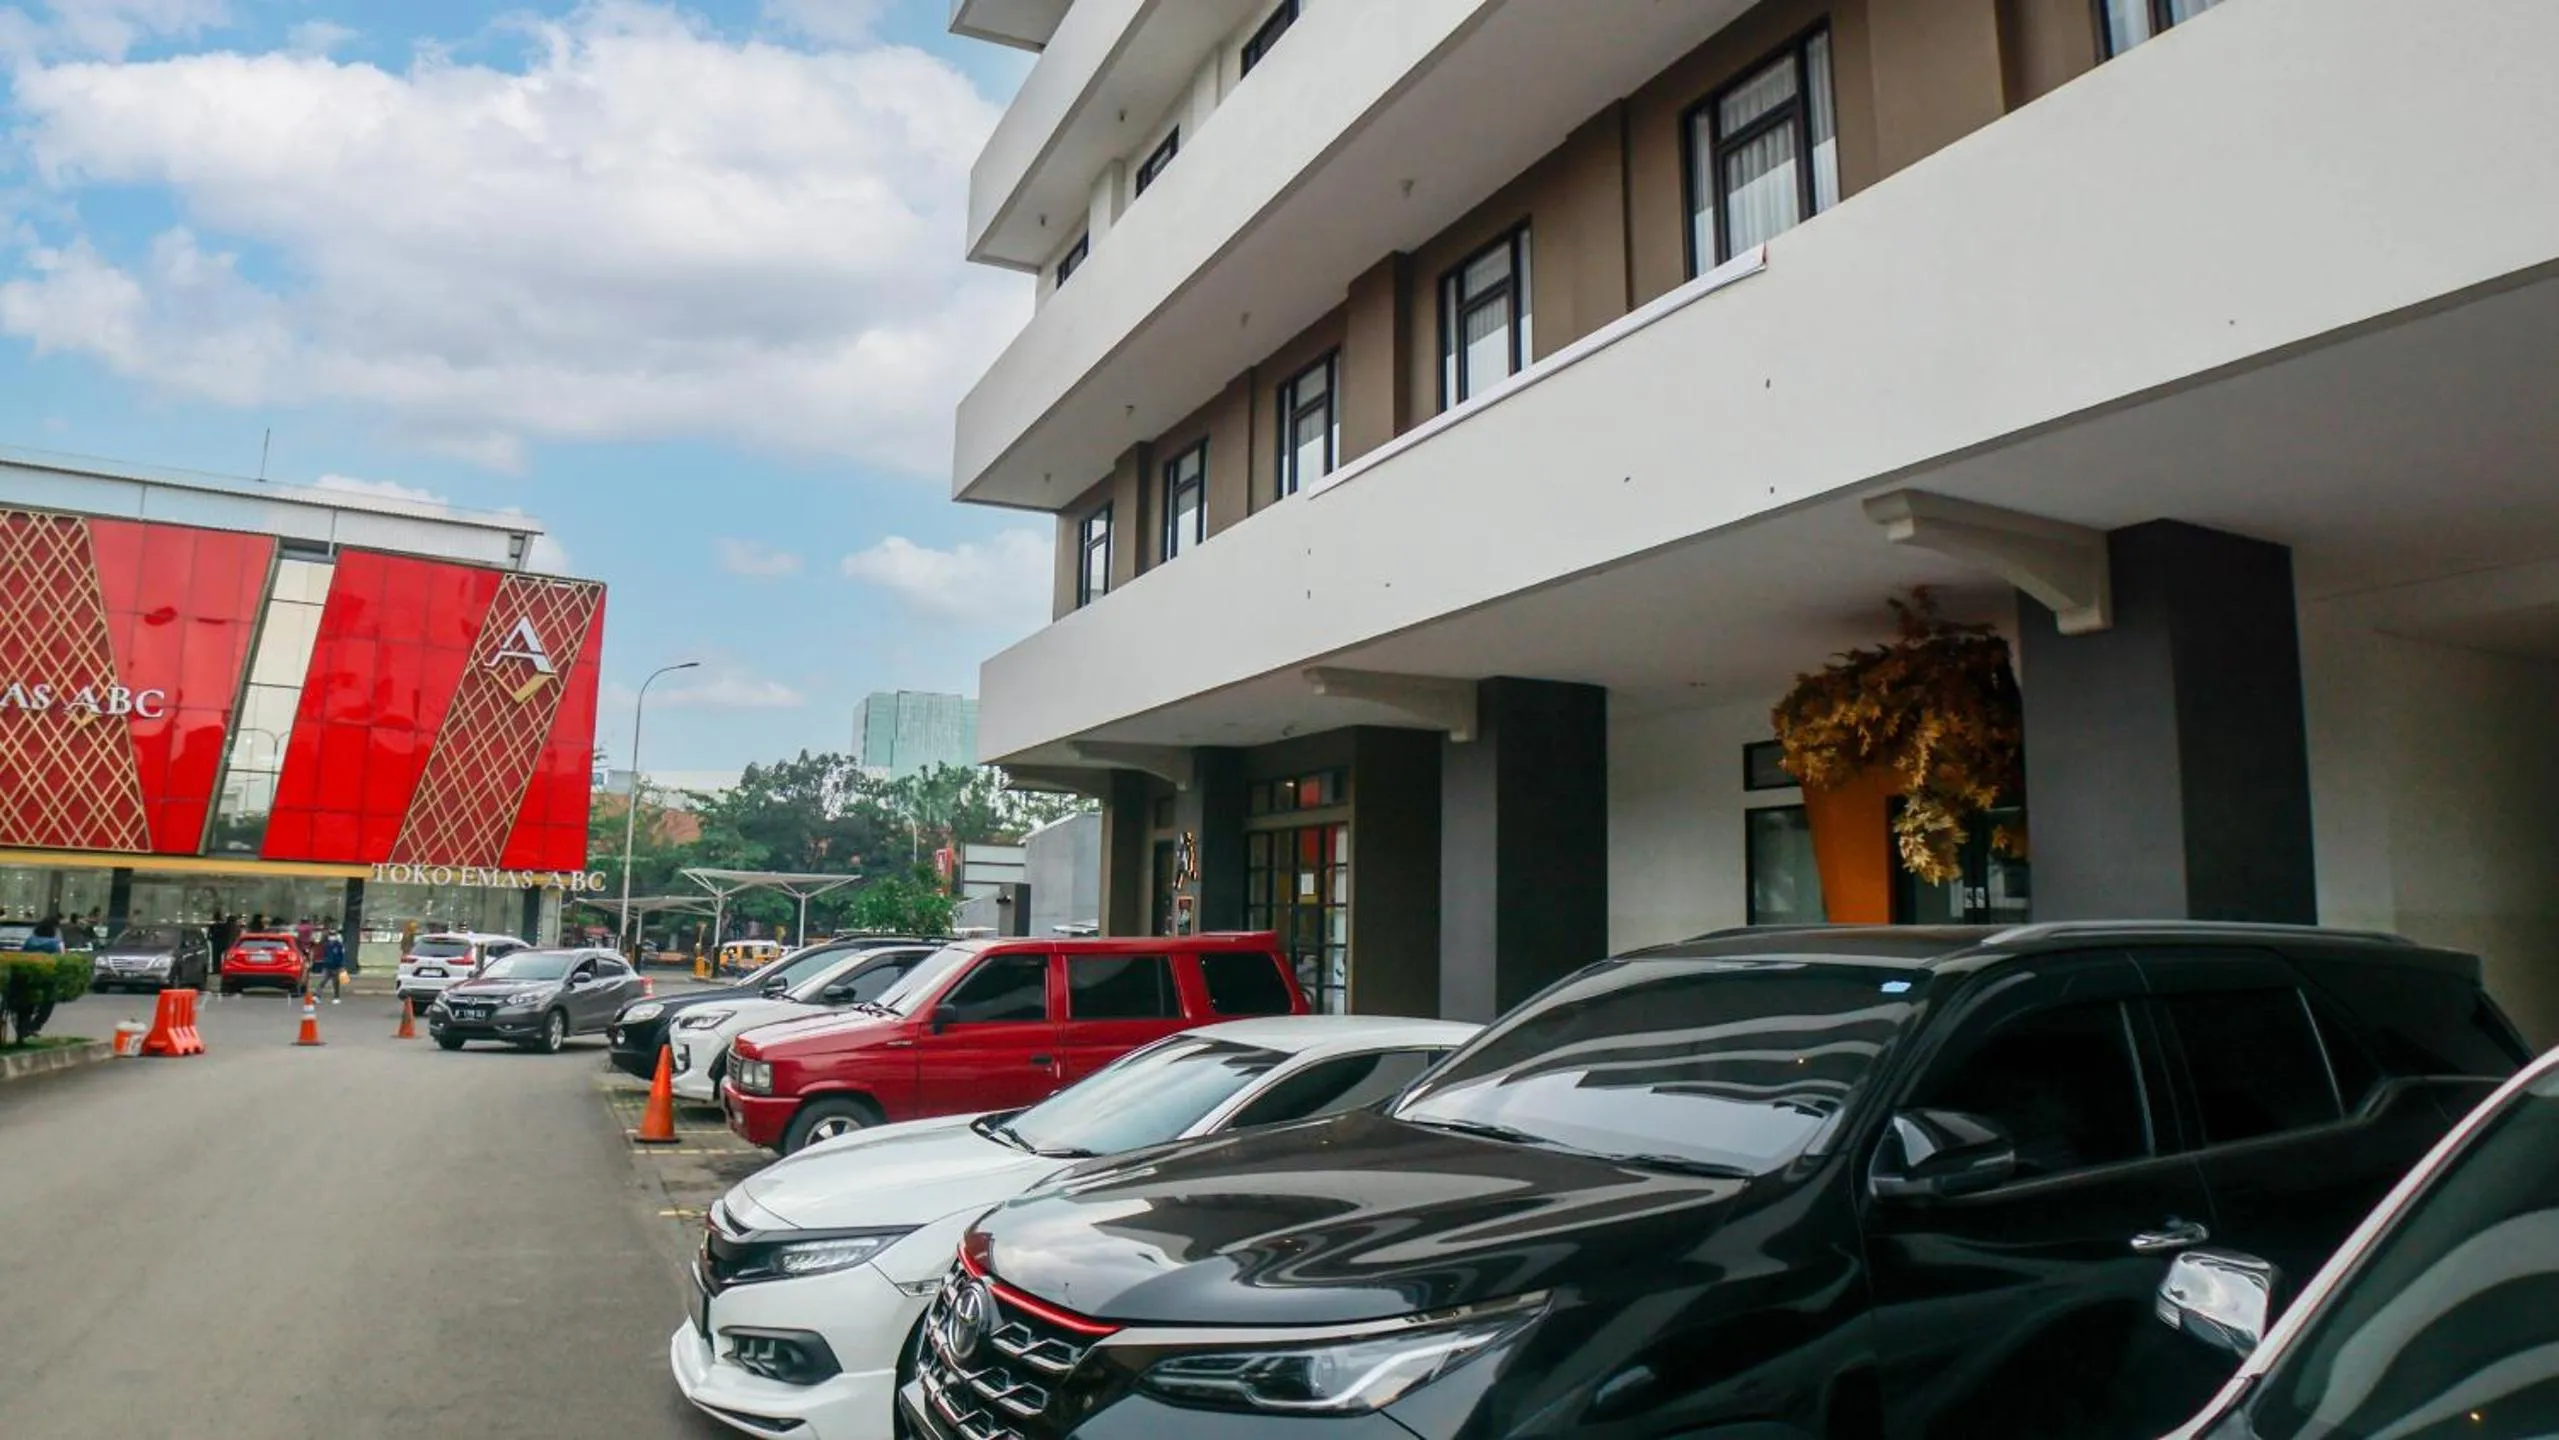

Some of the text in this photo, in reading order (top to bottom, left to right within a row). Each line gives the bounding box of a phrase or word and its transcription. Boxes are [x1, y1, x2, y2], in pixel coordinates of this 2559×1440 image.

[65, 685, 165, 719] ABC
[372, 863, 607, 892] TOKO EMAS ABC
